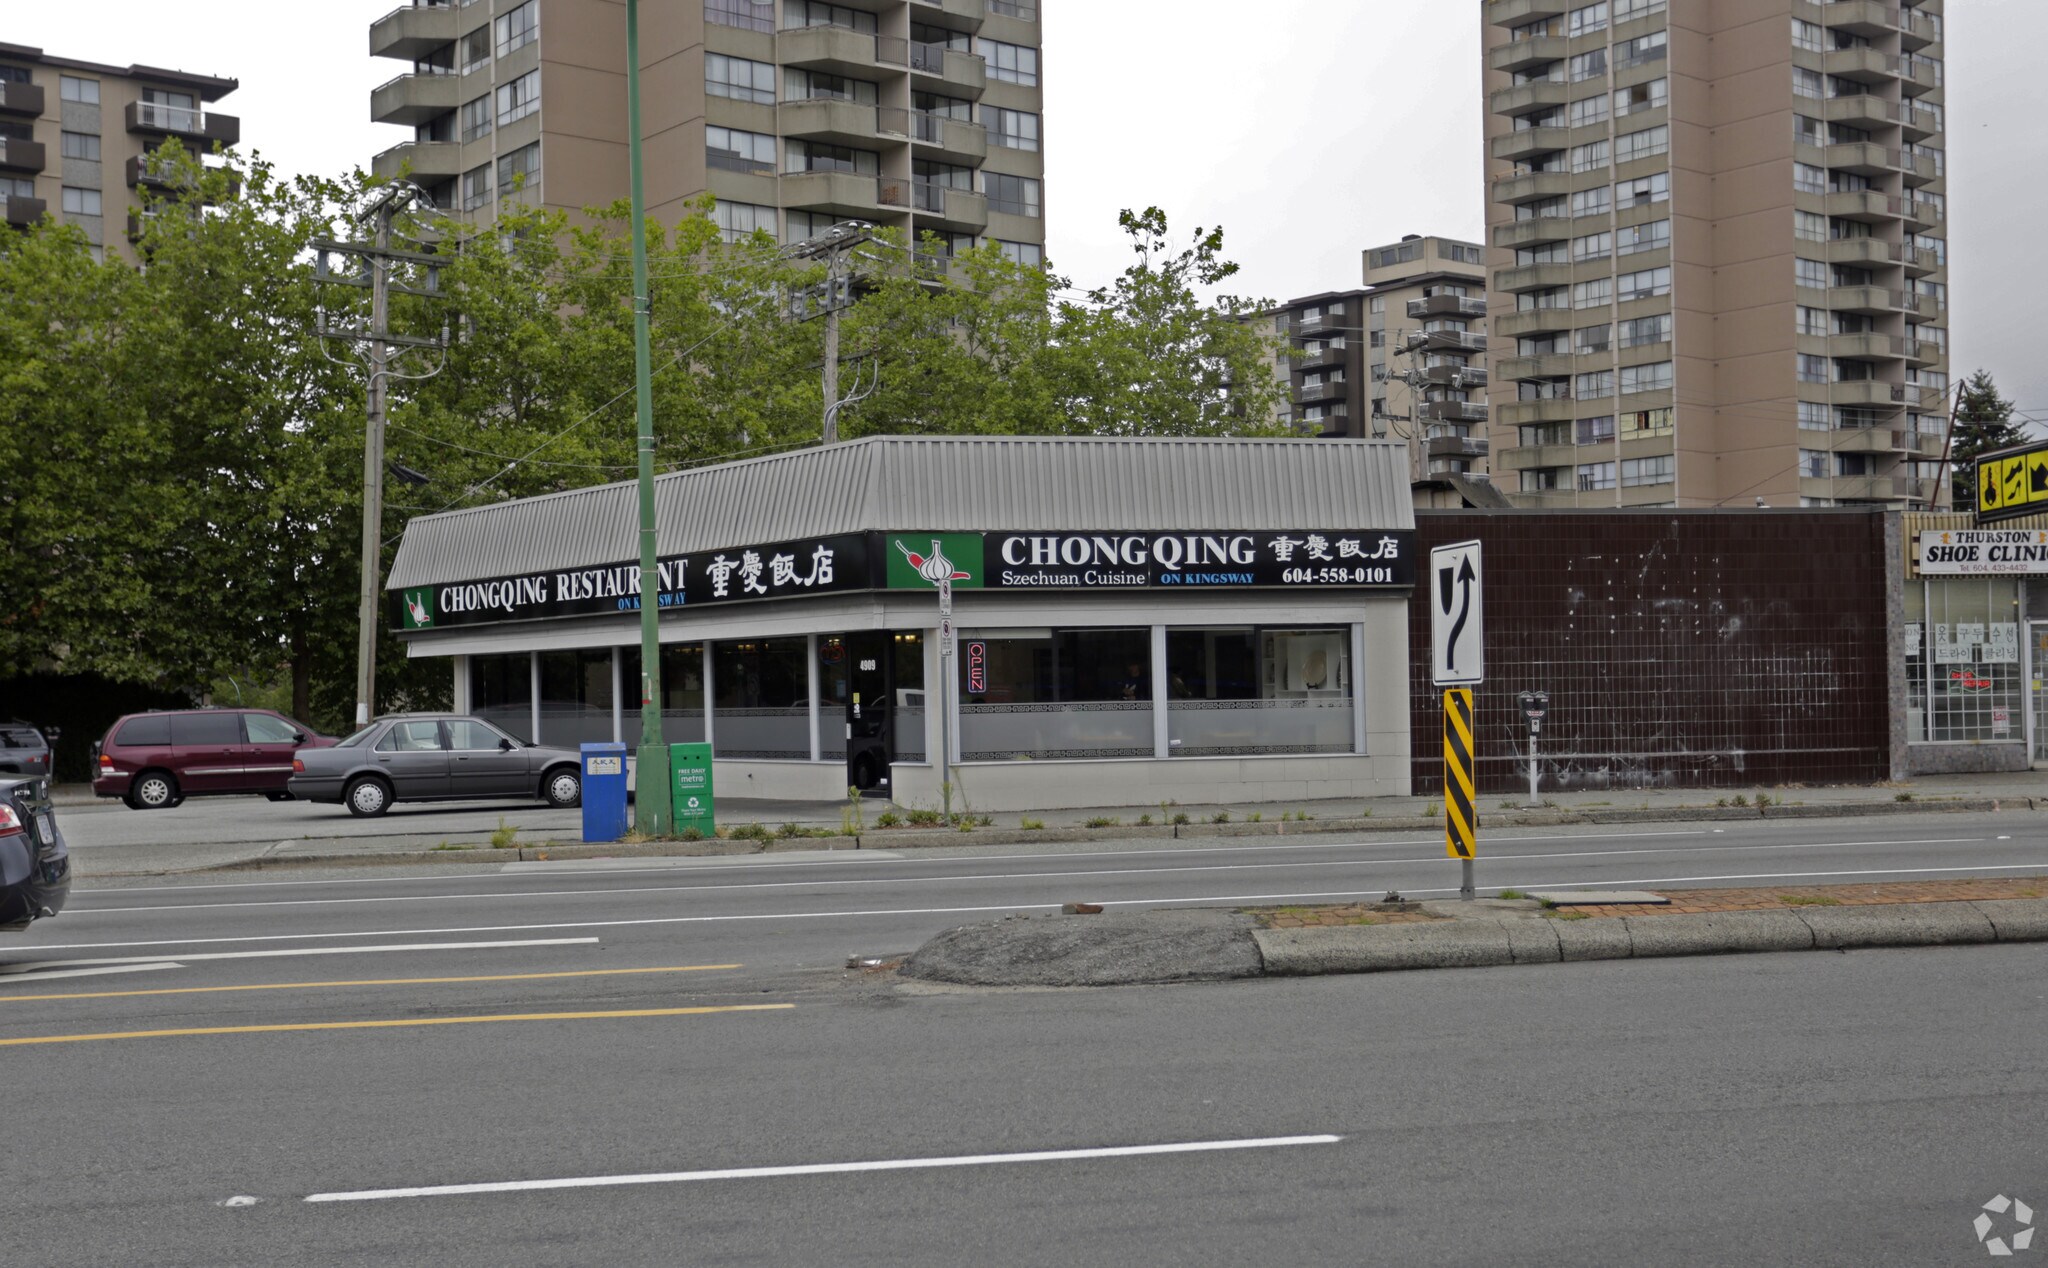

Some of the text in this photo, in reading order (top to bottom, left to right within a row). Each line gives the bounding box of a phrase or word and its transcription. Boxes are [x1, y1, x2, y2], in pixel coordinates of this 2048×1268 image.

[1956, 531, 2032, 544] THURSTON
[1267, 534, 1399, 562] 重慶飯店
[1926, 545, 2048, 563] SHOE CLINI
[705, 544, 834, 598] 重慶飯店
[1002, 570, 1146, 585] Szechuan Cuisine
[1160, 573, 1254, 584] ON KINGSWAY
[1282, 567, 1393, 583] 604-558-0101
[440, 559, 689, 613] CHONGQING RESTAURNT
[618, 592, 686, 610] ON KSWAY
[860, 659, 876, 671] 4909
[970, 644, 983, 690] OPEN
[680, 775, 704, 783] metro
